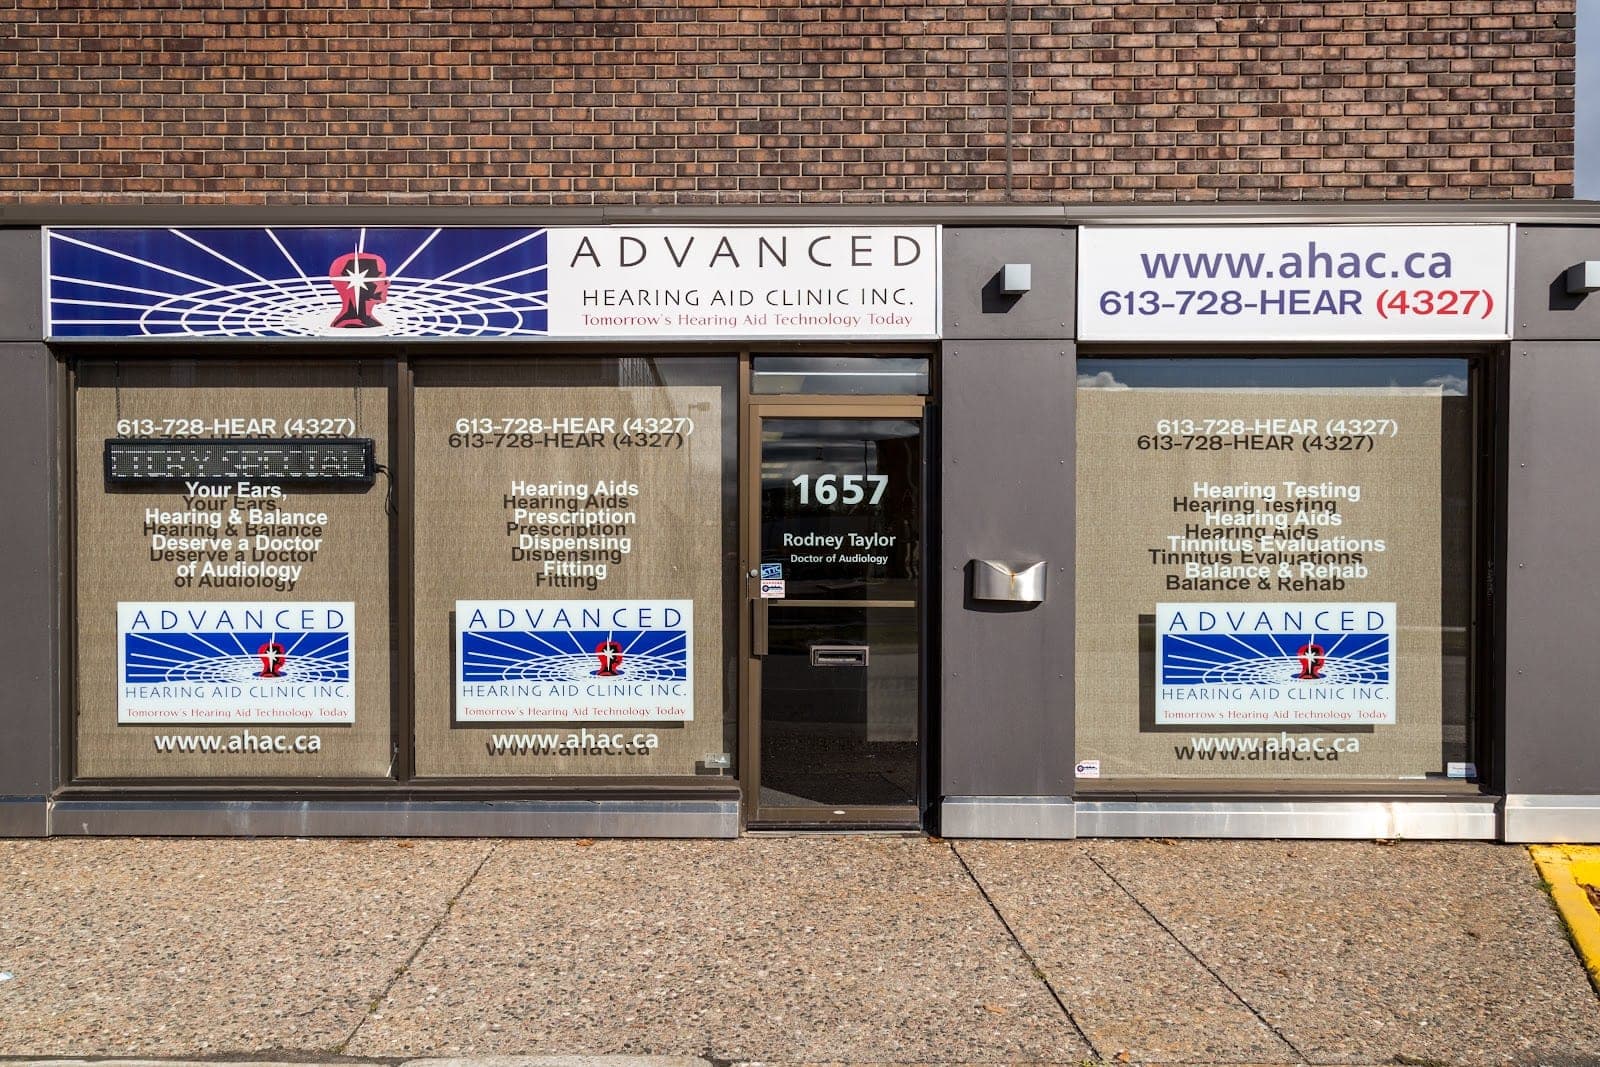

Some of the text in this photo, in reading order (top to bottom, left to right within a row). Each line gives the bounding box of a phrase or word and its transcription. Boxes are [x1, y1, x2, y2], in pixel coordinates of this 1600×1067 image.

[571, 236, 920, 268] ADVANCED
[1140, 242, 1451, 278] www.ahac.ca
[583, 287, 913, 307] HEARING AID CLINIC INC.
[1100, 290, 1493, 319] 613-728-HEAR (4327)
[583, 312, 911, 328] Tomorrow's Hearing Aid Technology Today
[117, 417, 355, 437] 613-728-HEAR (4327)
[455, 417, 695, 436] 613-728-HEAR (4327)
[1157, 418, 1398, 438] 613-728-HEAR (4327)
[186, 481, 287, 501] Your Ears,
[511, 480, 639, 500] Hearing Aids
[793, 474, 888, 504] 1657
[1194, 482, 1360, 502] Hearing Testing
[145, 508, 328, 529] Hearing & Balance
[514, 508, 636, 528] Prescription
[1206, 509, 1342, 530] Hearing Aids
[152, 534, 323, 551] Deserve a Doctor
[519, 533, 631, 554] Dispensing
[783, 532, 897, 550] Rodney Taylor
[1166, 535, 1386, 552] Tinnitus Evaluations
[790, 553, 889, 565] Doctor of Audiology
[177, 560, 301, 581] of Audiology
[544, 560, 607, 580] Fitting
[1185, 561, 1368, 579] Balance & Rehab
[132, 610, 343, 630] ADVANCED
[469, 608, 680, 628] ADVANCED
[1169, 611, 1383, 631] ADVANCED
[125, 685, 349, 699] HEARING AID CLINIC INC.
[463, 683, 687, 697] HEARING AID CLINIC INC.
[1162, 687, 1389, 701] HEARING AID CLINIC INC.
[127, 707, 348, 719] Tomorrow's Hearing Aid Technology Today
[464, 706, 685, 717] Tomorrow's Hearing Aid Technology Today
[1163, 709, 1387, 721] Tomorrow's Hearing Aid Technology Today
[154, 729, 321, 750] www.ahac.ca
[492, 728, 658, 749] www.ahac.ca
[1192, 732, 1359, 752] www.ahac.ca
